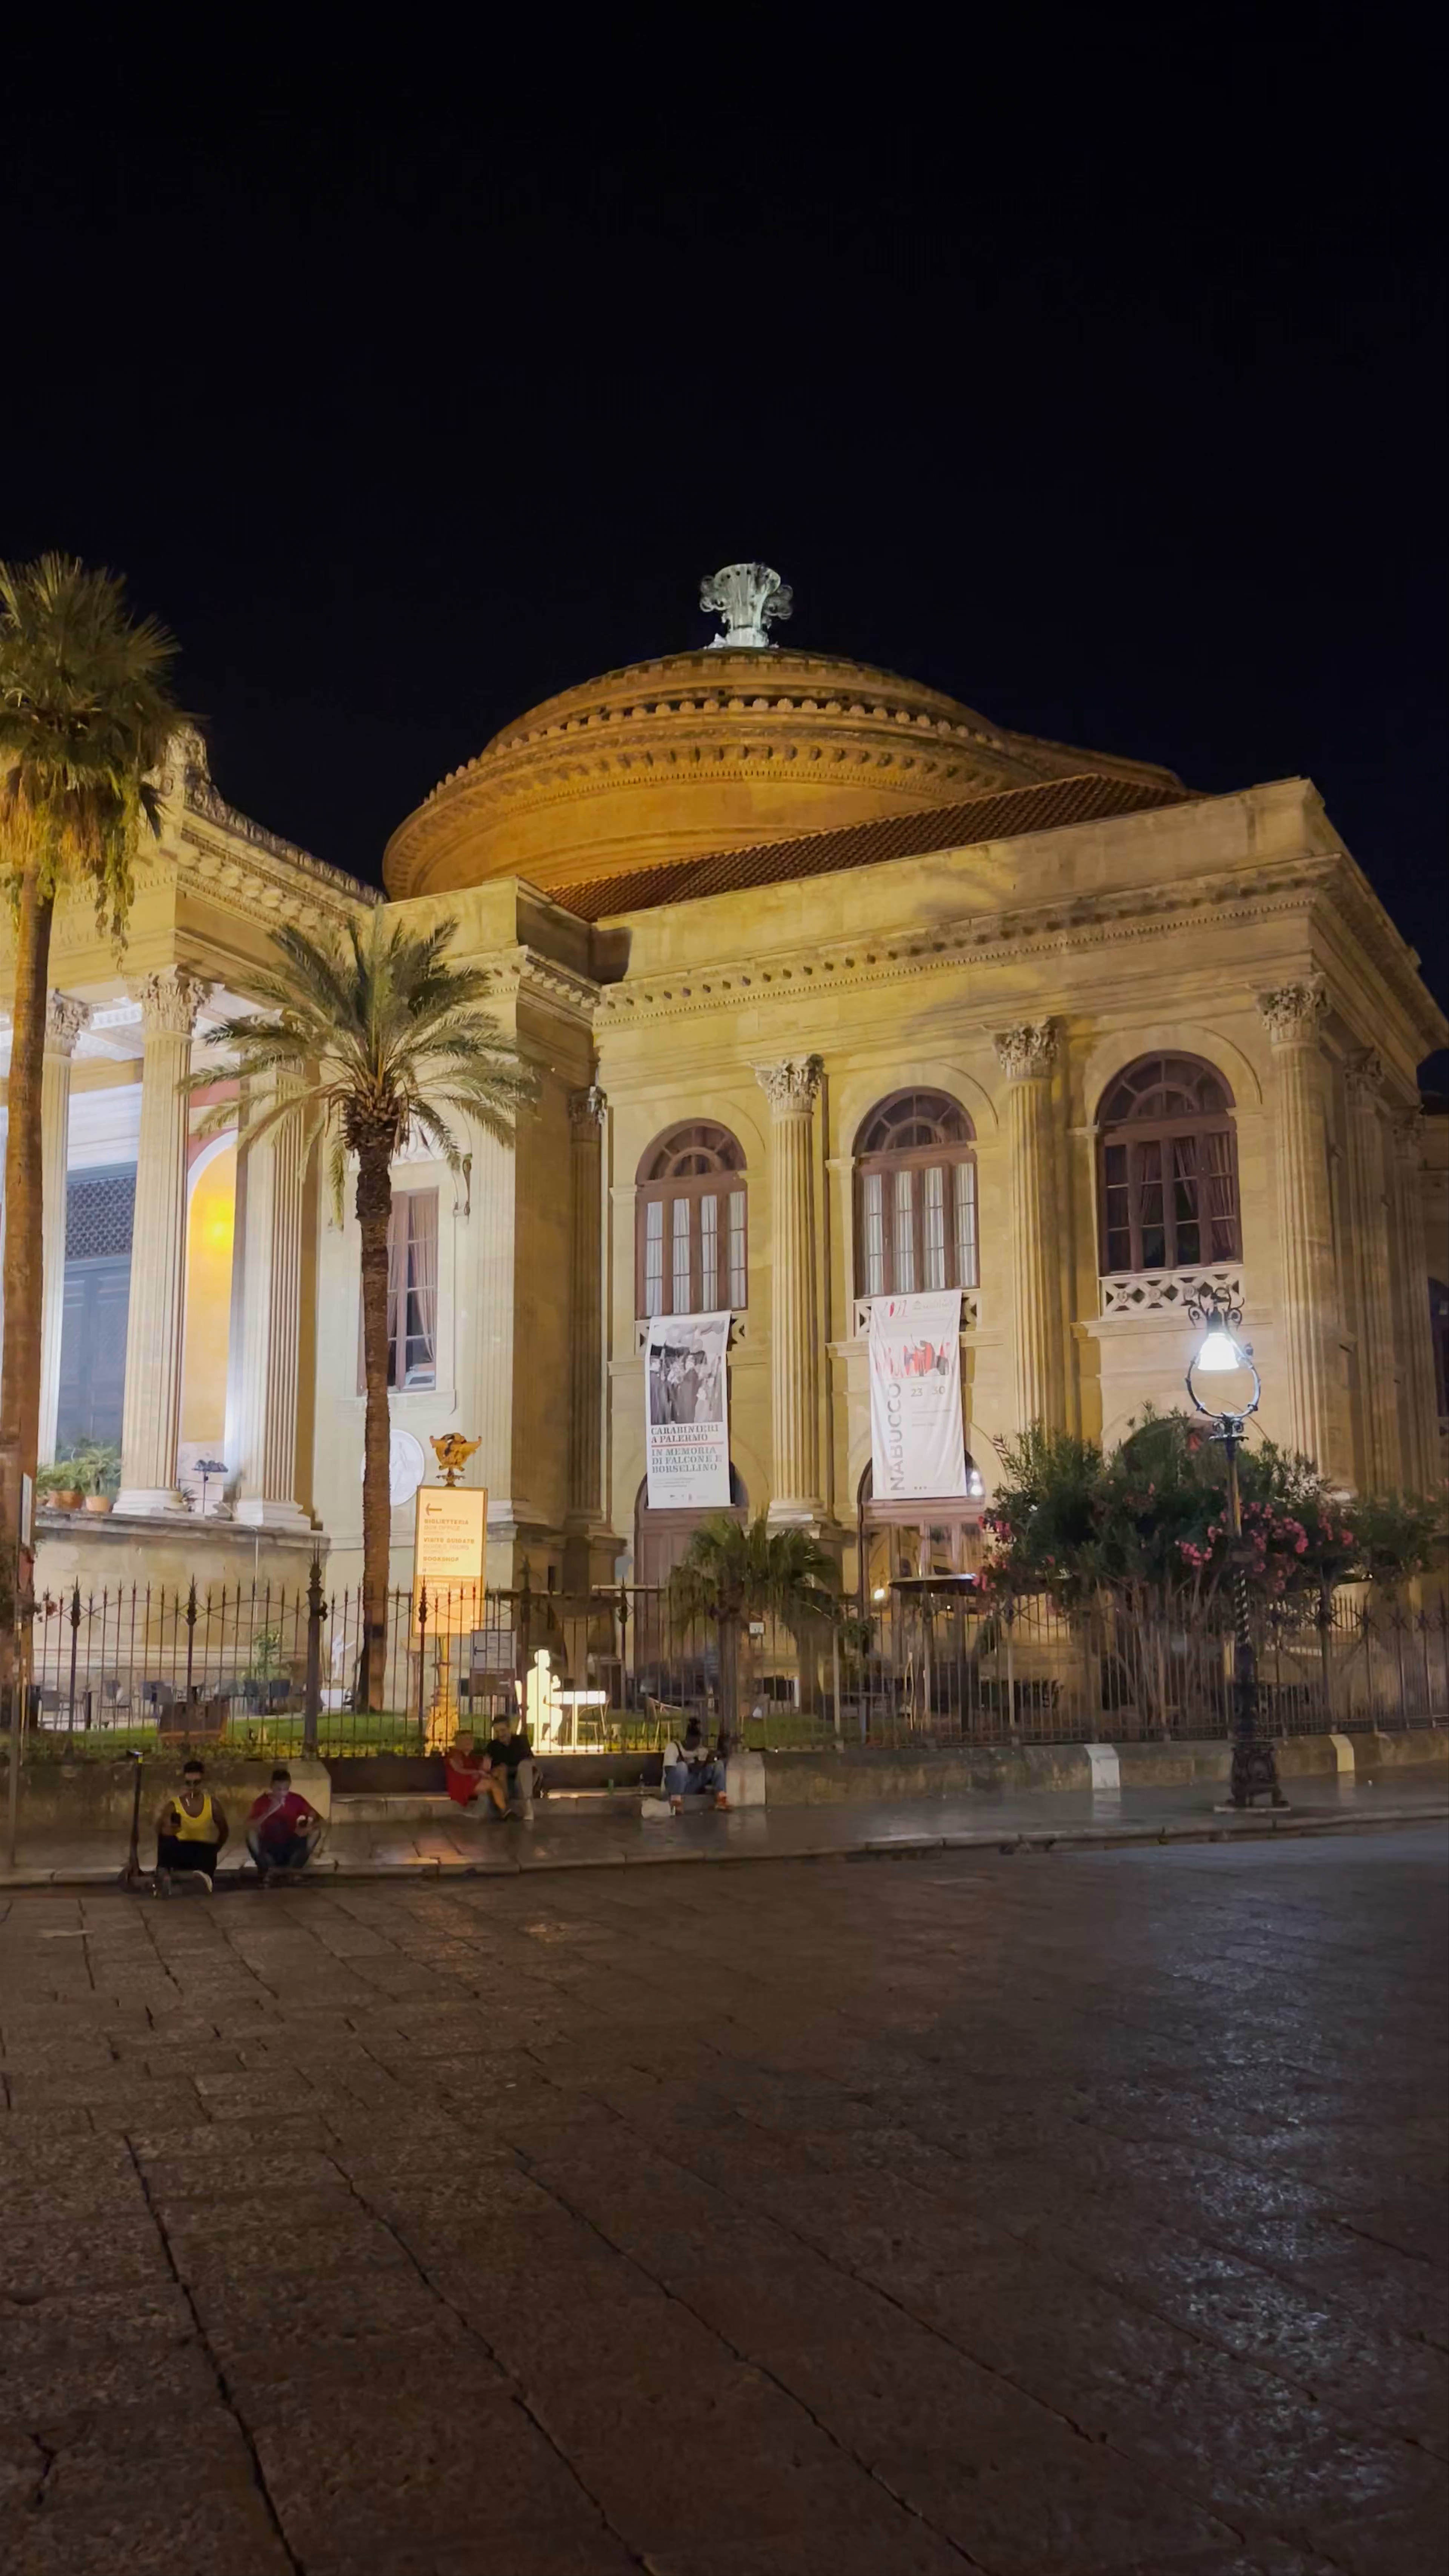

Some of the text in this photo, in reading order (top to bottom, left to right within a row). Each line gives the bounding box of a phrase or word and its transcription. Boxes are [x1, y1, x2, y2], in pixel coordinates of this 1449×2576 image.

[911, 1387, 923, 1397] 23
[651, 1424, 718, 1435] CARABINIERI
[660, 1433, 708, 1443] PALERMO
[888, 1383, 904, 1490] NABUCCO
[666, 1446, 717, 1456] MEMORIA
[652, 1457, 663, 1465] DI
[666, 1455, 712, 1464] FALCONE
[652, 1463, 717, 1473] BORSELLINO
